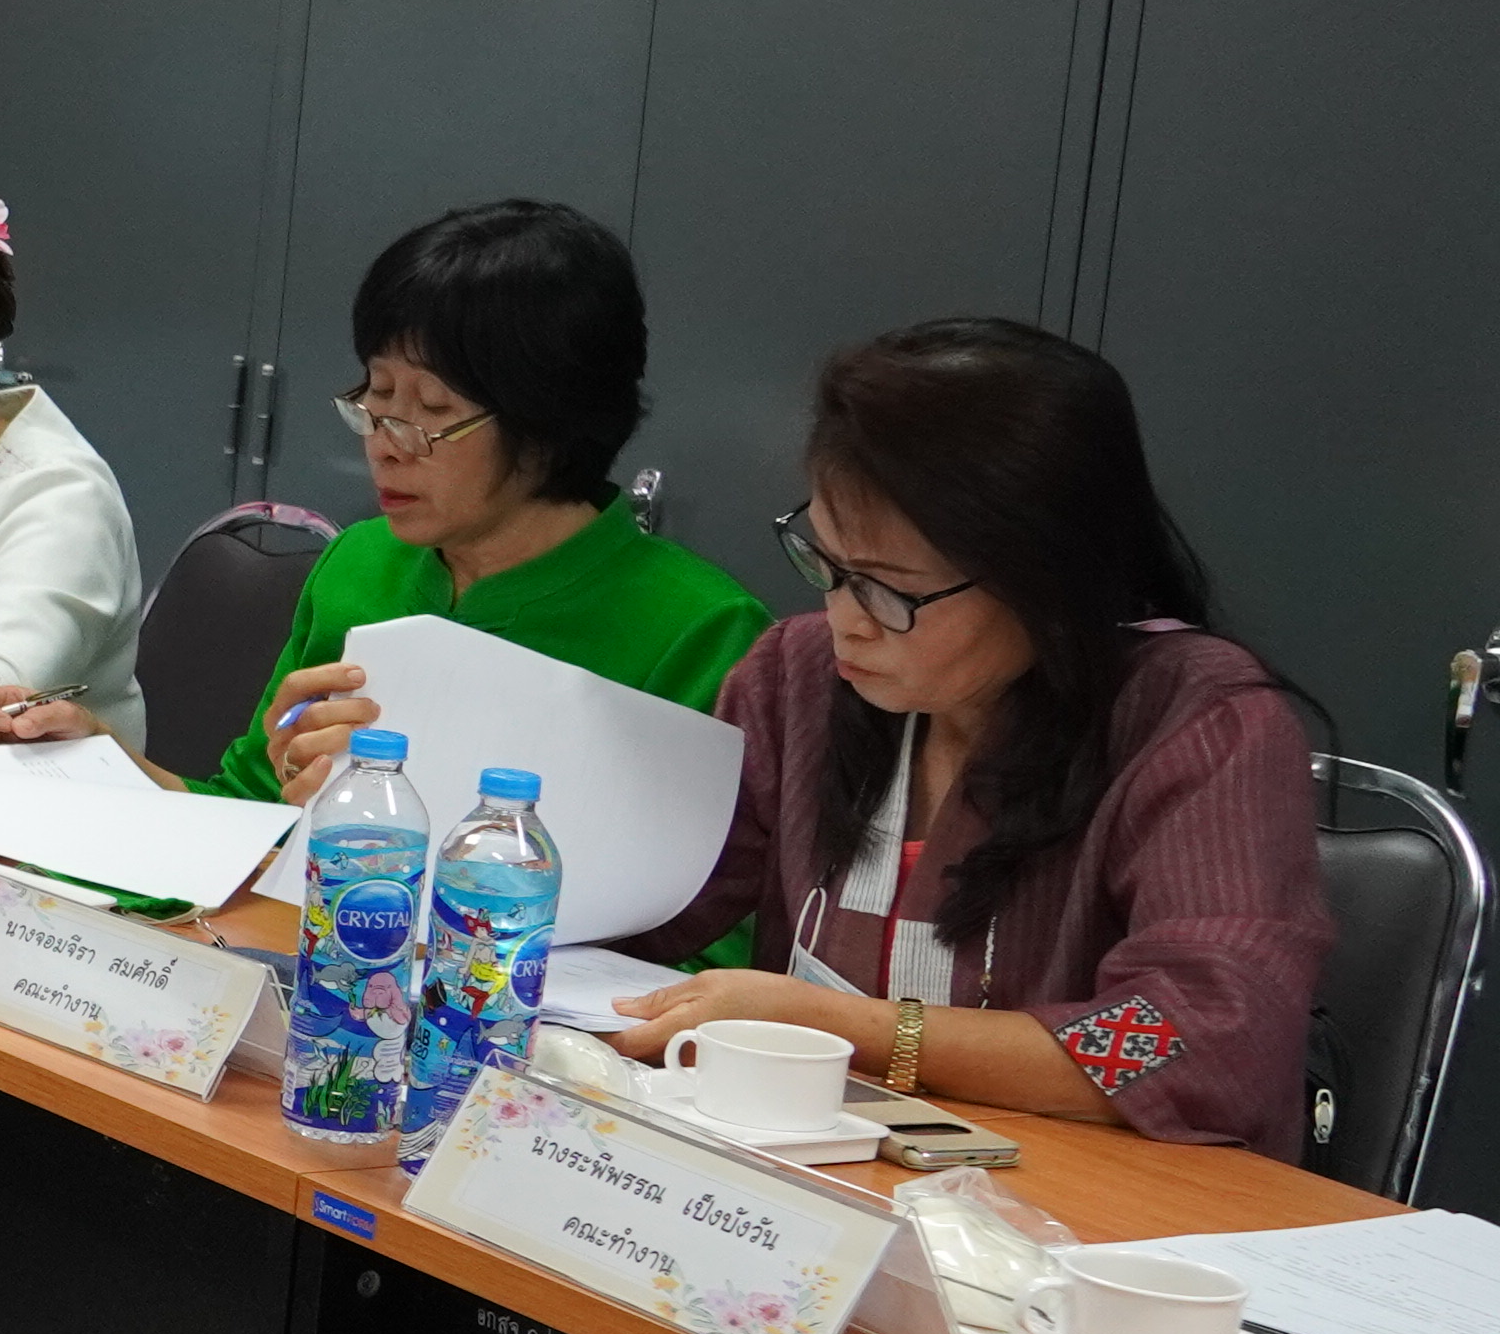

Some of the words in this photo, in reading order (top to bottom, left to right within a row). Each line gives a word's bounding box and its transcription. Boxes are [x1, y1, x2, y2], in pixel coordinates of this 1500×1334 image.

[337, 909, 410, 929] CRYSTAL
[107, 956, 179, 992] สมศักดิ์
[512, 960, 546, 978] CRYS
[12, 977, 102, 1022] คณะทำงาน
[530, 1132, 668, 1206] นางระพีพรรณ
[562, 1213, 676, 1277] คณะทำงาน
